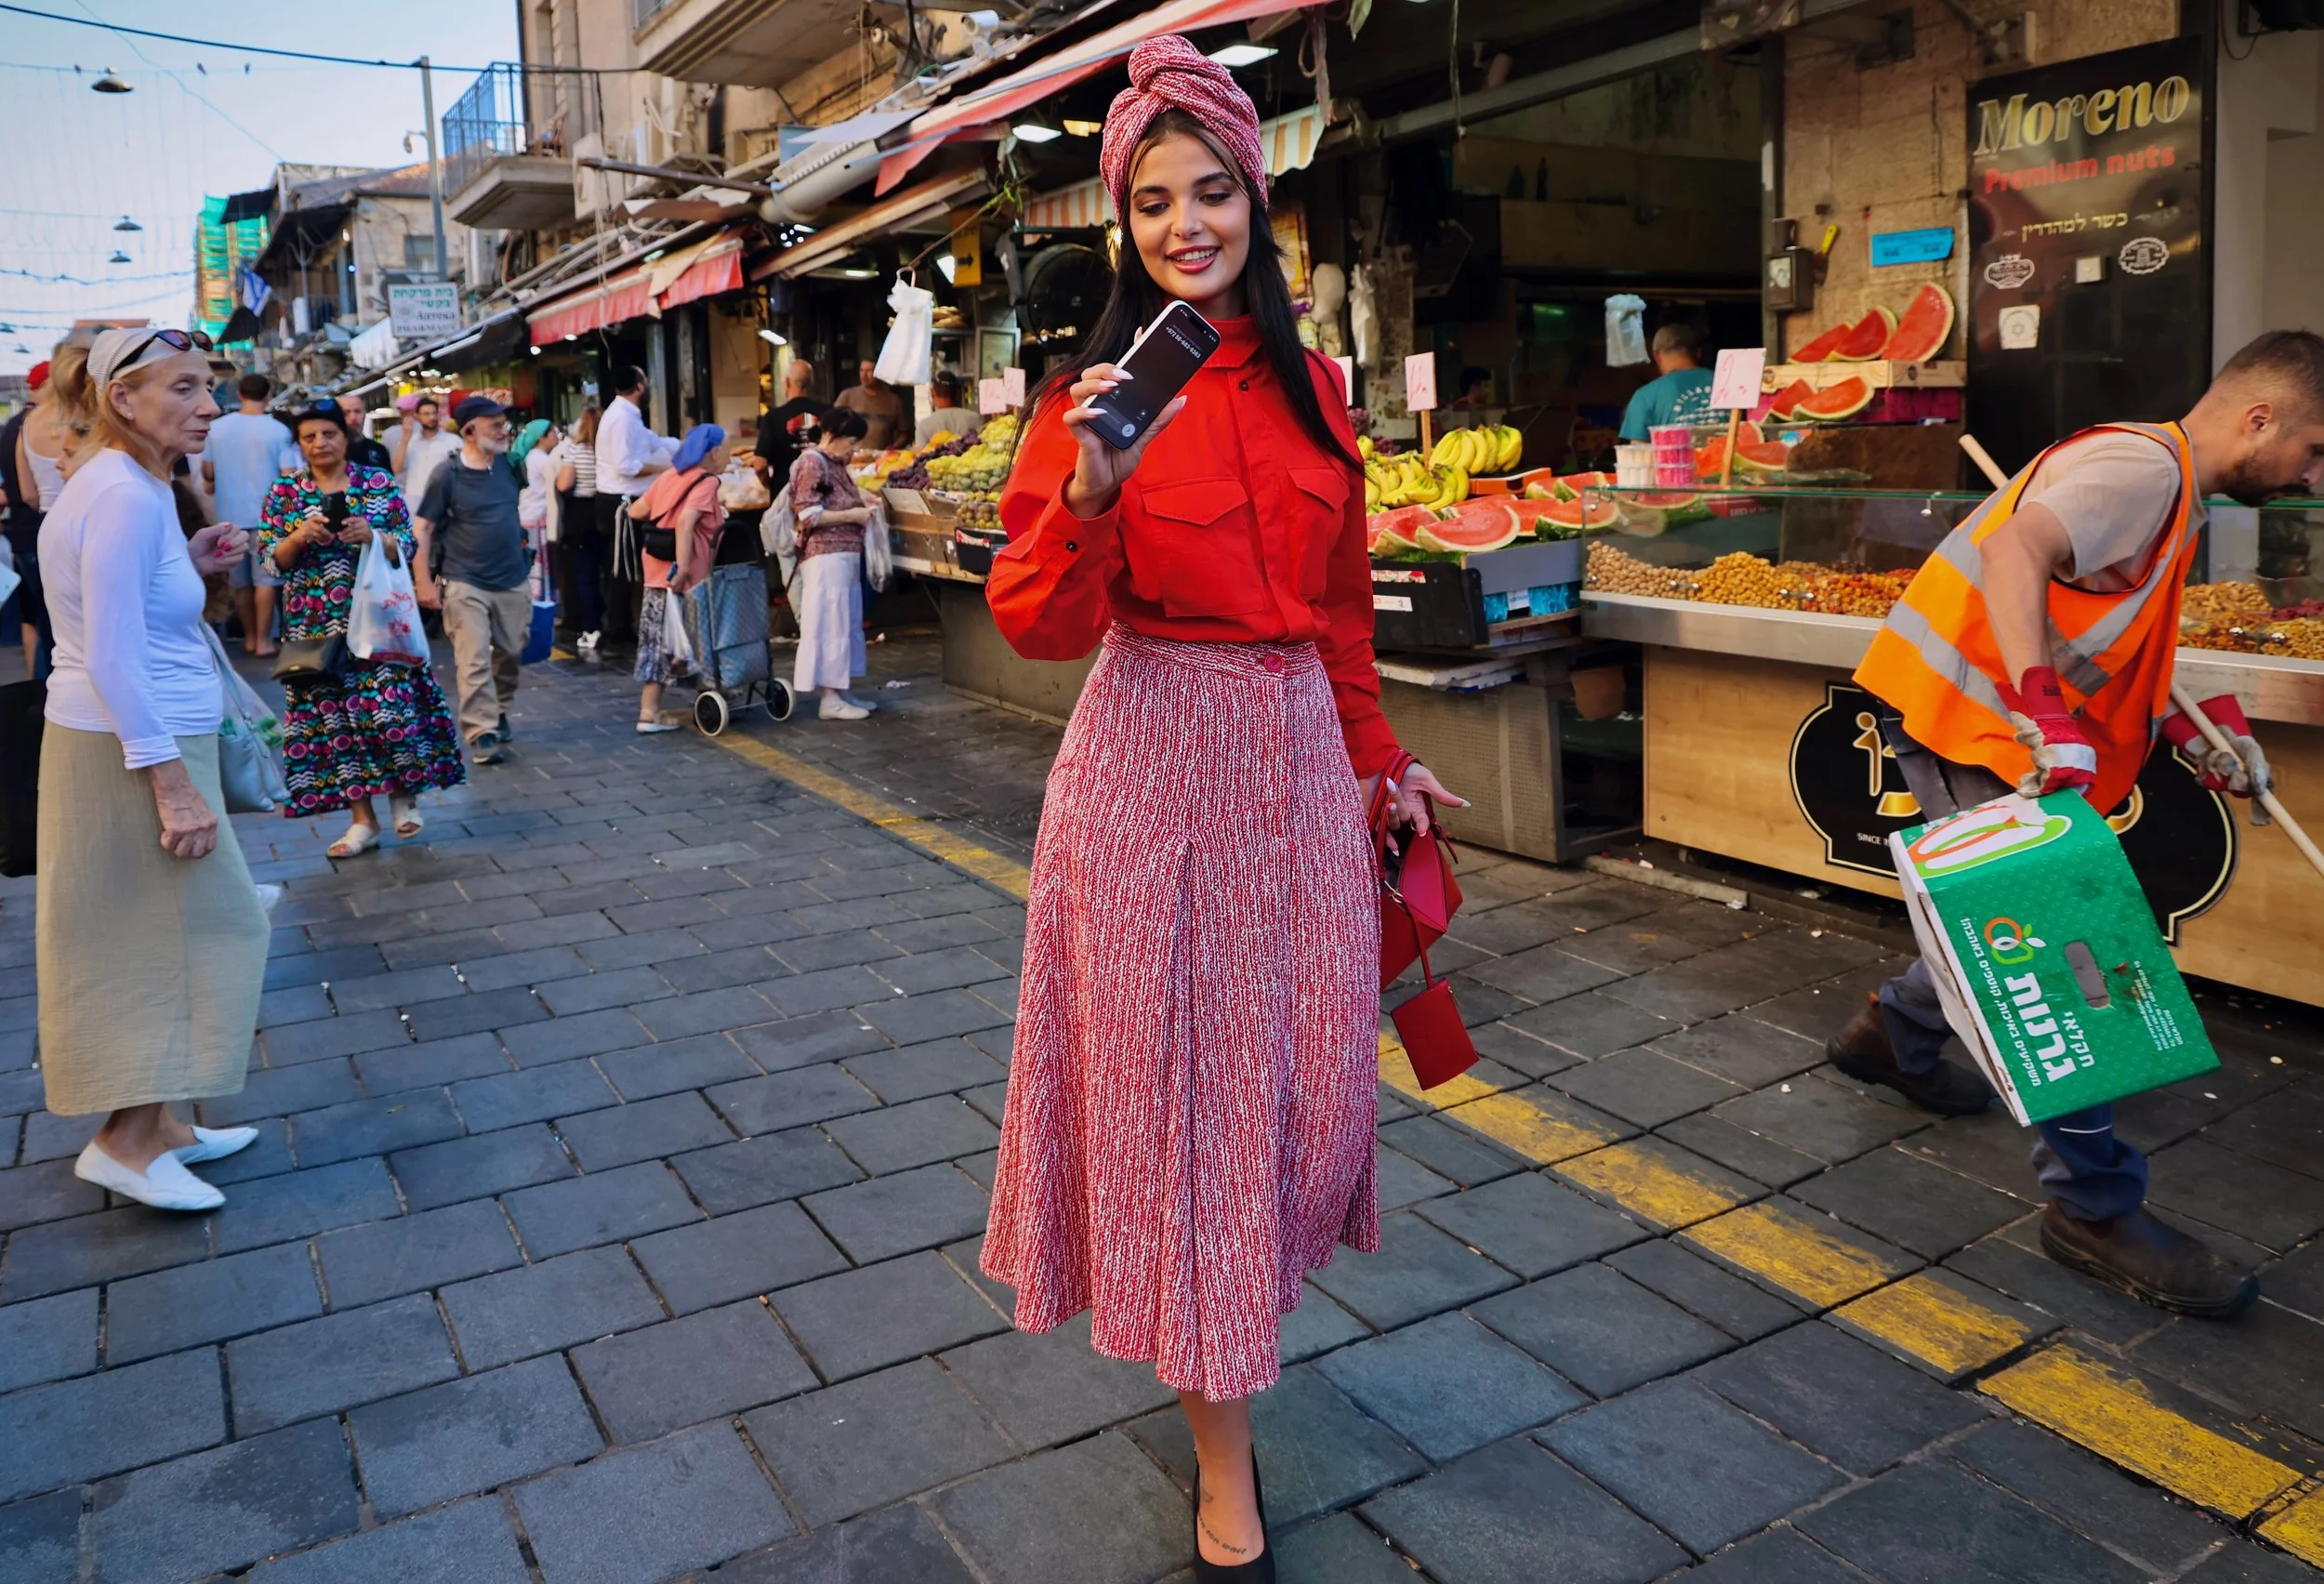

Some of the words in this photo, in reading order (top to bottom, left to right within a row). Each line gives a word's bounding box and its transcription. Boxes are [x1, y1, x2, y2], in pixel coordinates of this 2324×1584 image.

[1973, 75, 2190, 155] Moreno
[1984, 157, 2098, 194] Premium
[2106, 144, 2176, 175] nuts
[2020, 212, 2087, 244] למהדרין
[2091, 212, 2129, 229] כשר
[1856, 832, 1882, 845] SINCE
[1960, 917, 1984, 957] באהבה!
[1980, 961, 2000, 996] קוטפים
[1996, 1001, 2019, 1036] באיכות,
[2005, 973, 2076, 1081] גרנות
[2064, 1012, 2093, 1066] חקלאי
[2016, 1041, 2040, 1085] משקיעים
